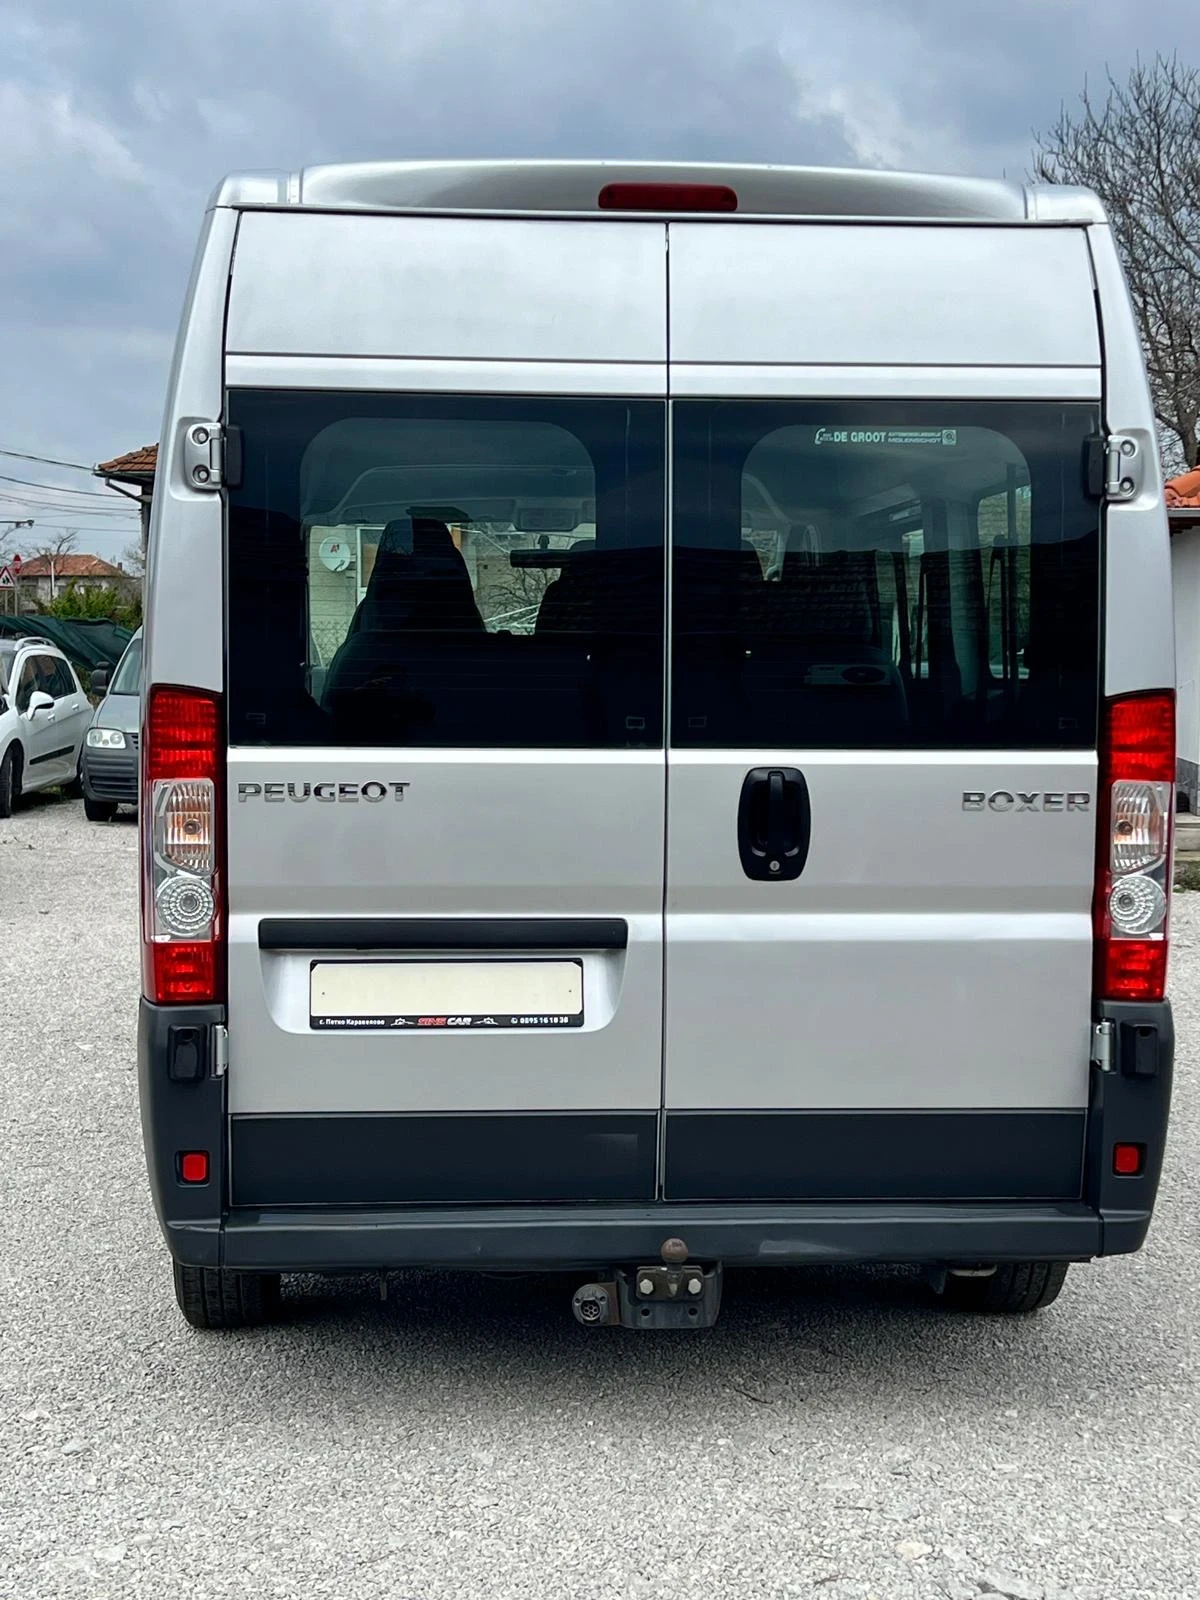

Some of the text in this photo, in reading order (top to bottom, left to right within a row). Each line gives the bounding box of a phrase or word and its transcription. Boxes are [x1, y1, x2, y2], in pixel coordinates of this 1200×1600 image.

[833, 431, 848, 442] DE
[850, 431, 886, 442] GROOT
[238, 781, 410, 803] PEUGEOT
[962, 790, 1090, 812] BOXER
[447, 1017, 472, 1025] CAR
